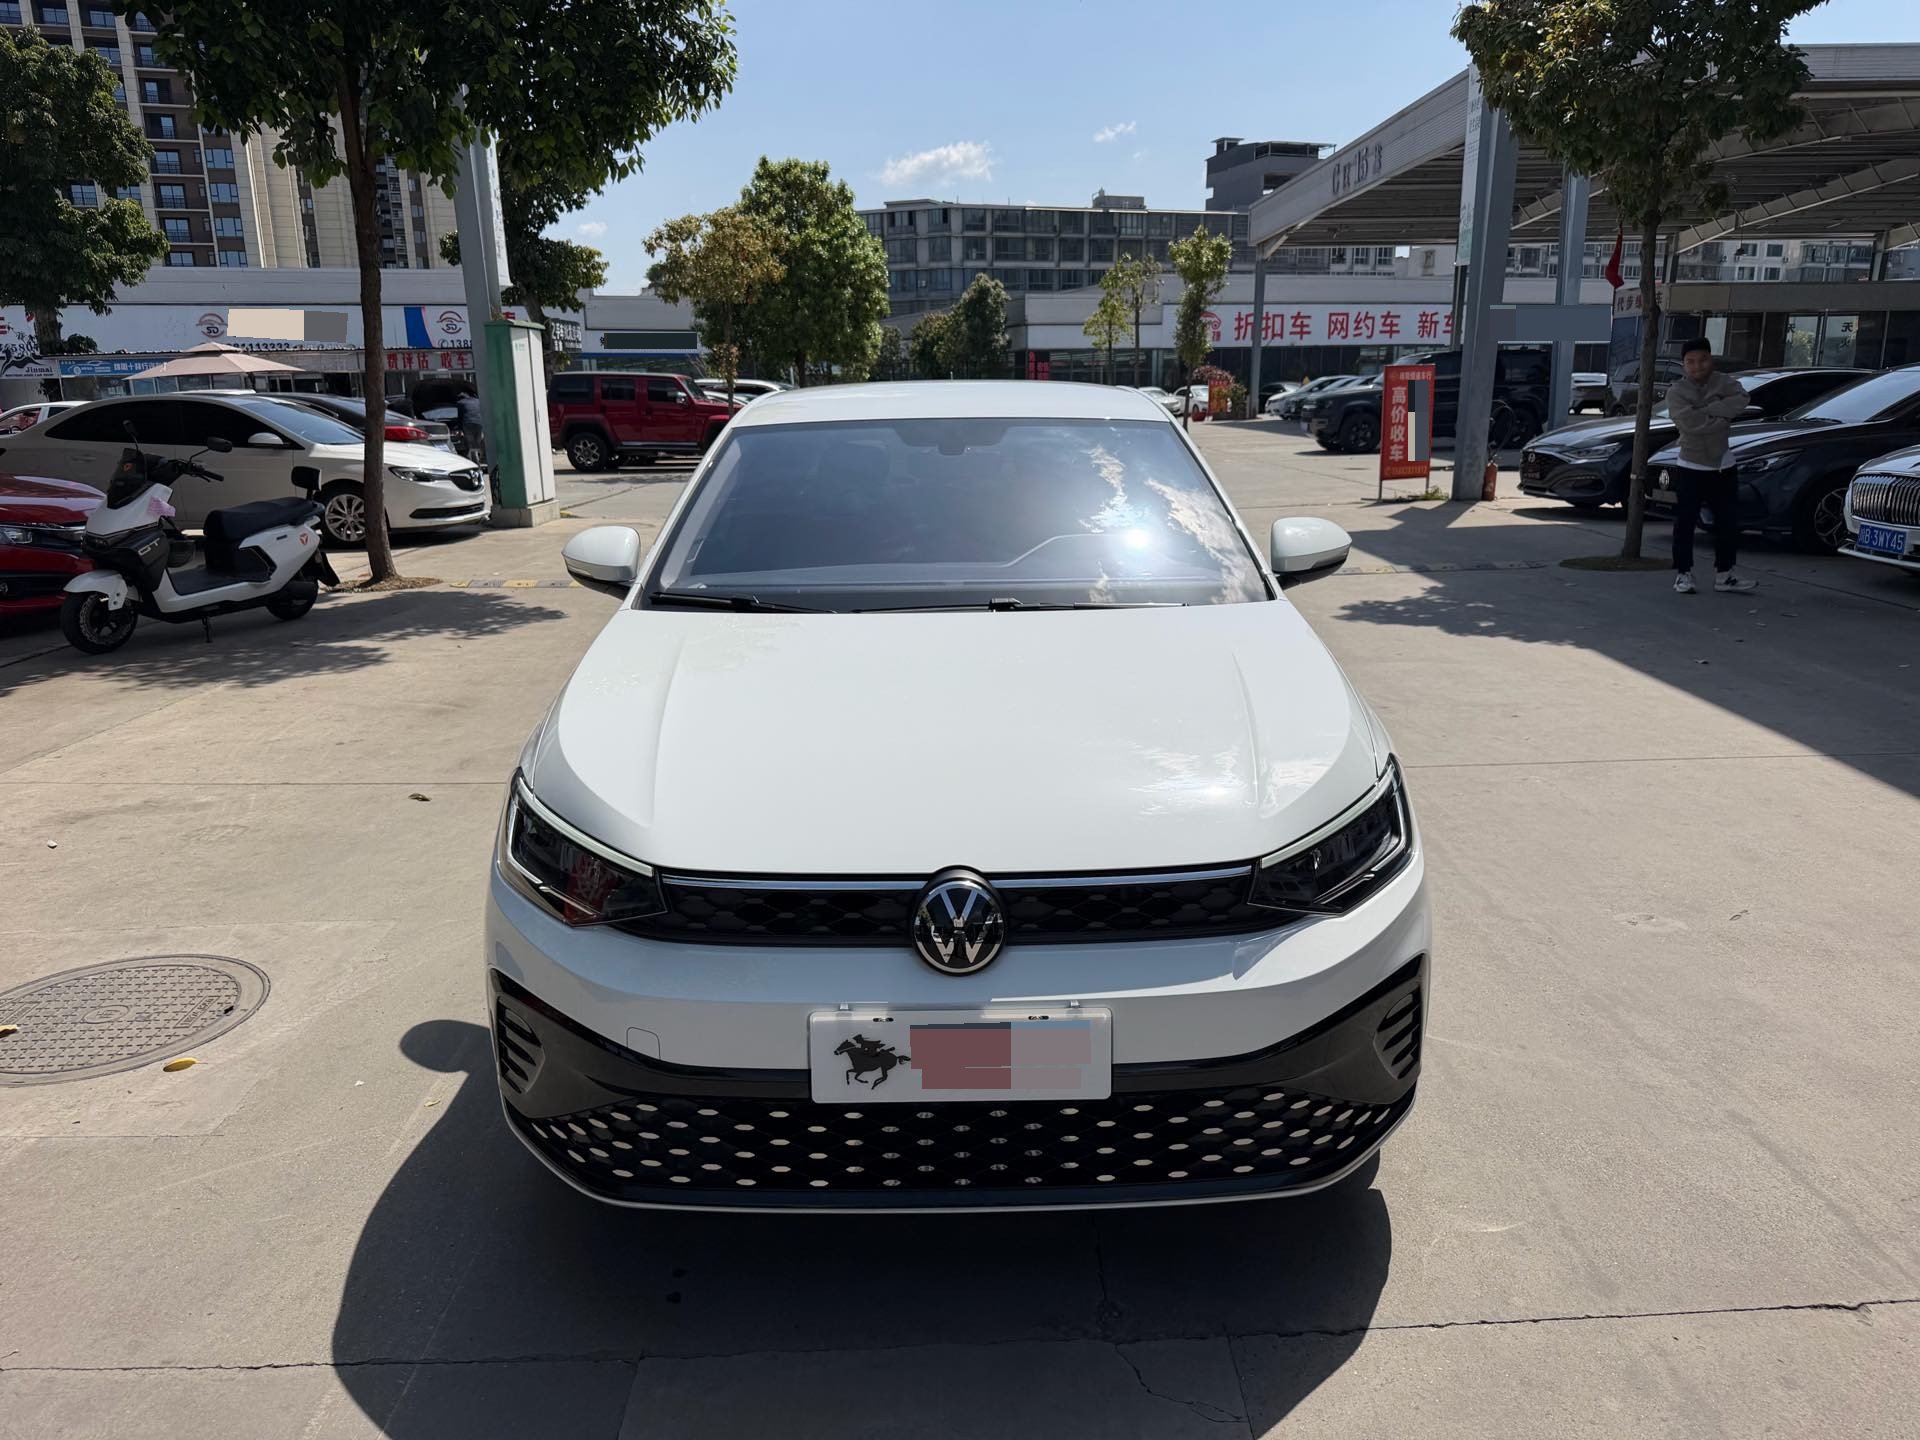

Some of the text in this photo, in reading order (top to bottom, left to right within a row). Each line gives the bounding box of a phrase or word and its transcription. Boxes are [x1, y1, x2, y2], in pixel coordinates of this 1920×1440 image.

[1234, 311, 1312, 341] 折扣车
[1327, 311, 1401, 339] 网约车
[1389, 386, 1407, 462] 高价收车
